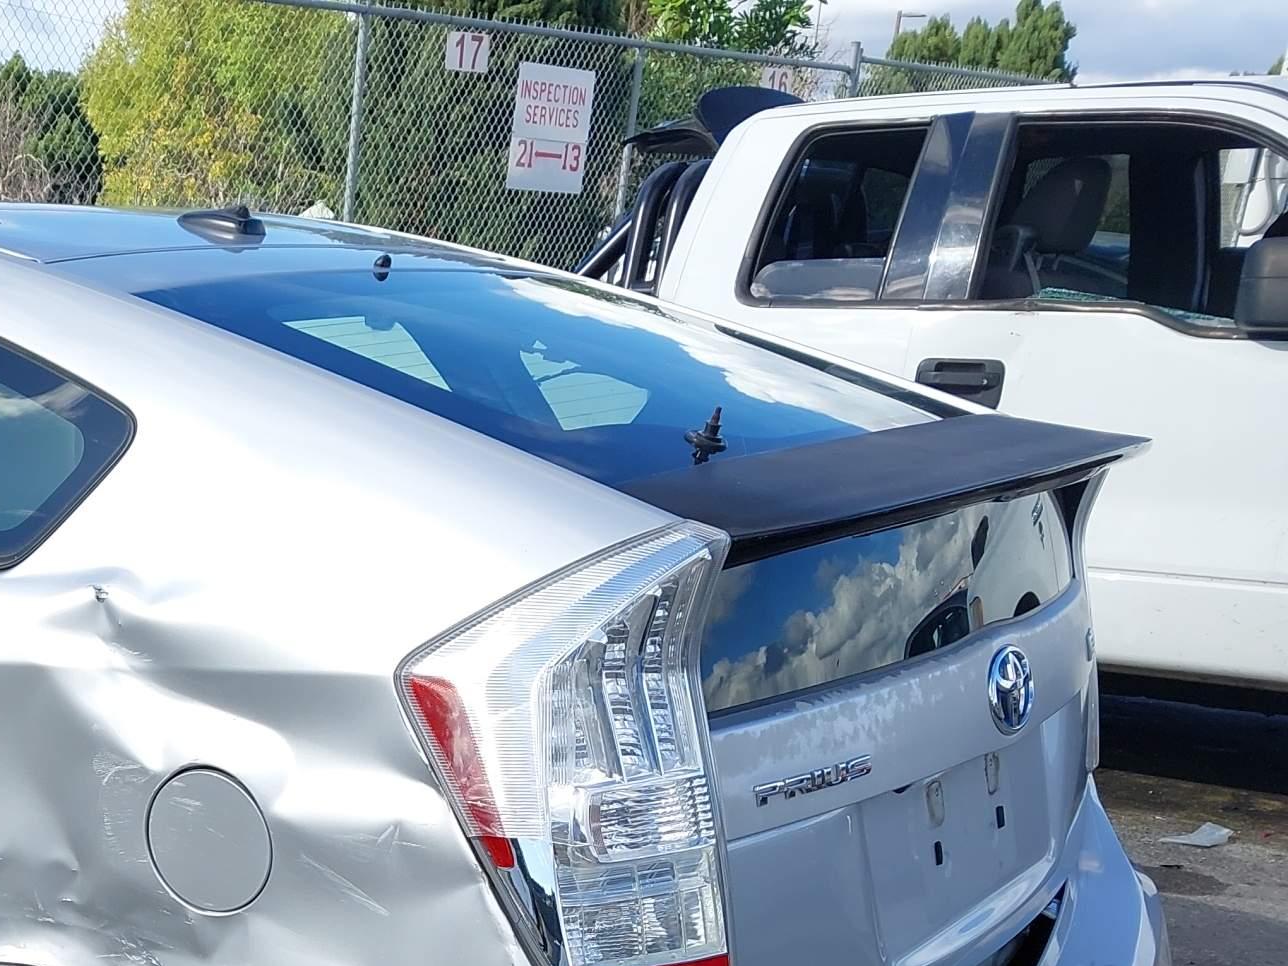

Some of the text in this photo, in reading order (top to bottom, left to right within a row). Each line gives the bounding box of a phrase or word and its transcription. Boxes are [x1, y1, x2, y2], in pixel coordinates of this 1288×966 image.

[455, 33, 484, 70] 17
[520, 79, 587, 107] INSPECTION
[768, 70, 788, 94] 16
[525, 104, 579, 129] SERVICES
[753, 754, 872, 808] PRIUS
